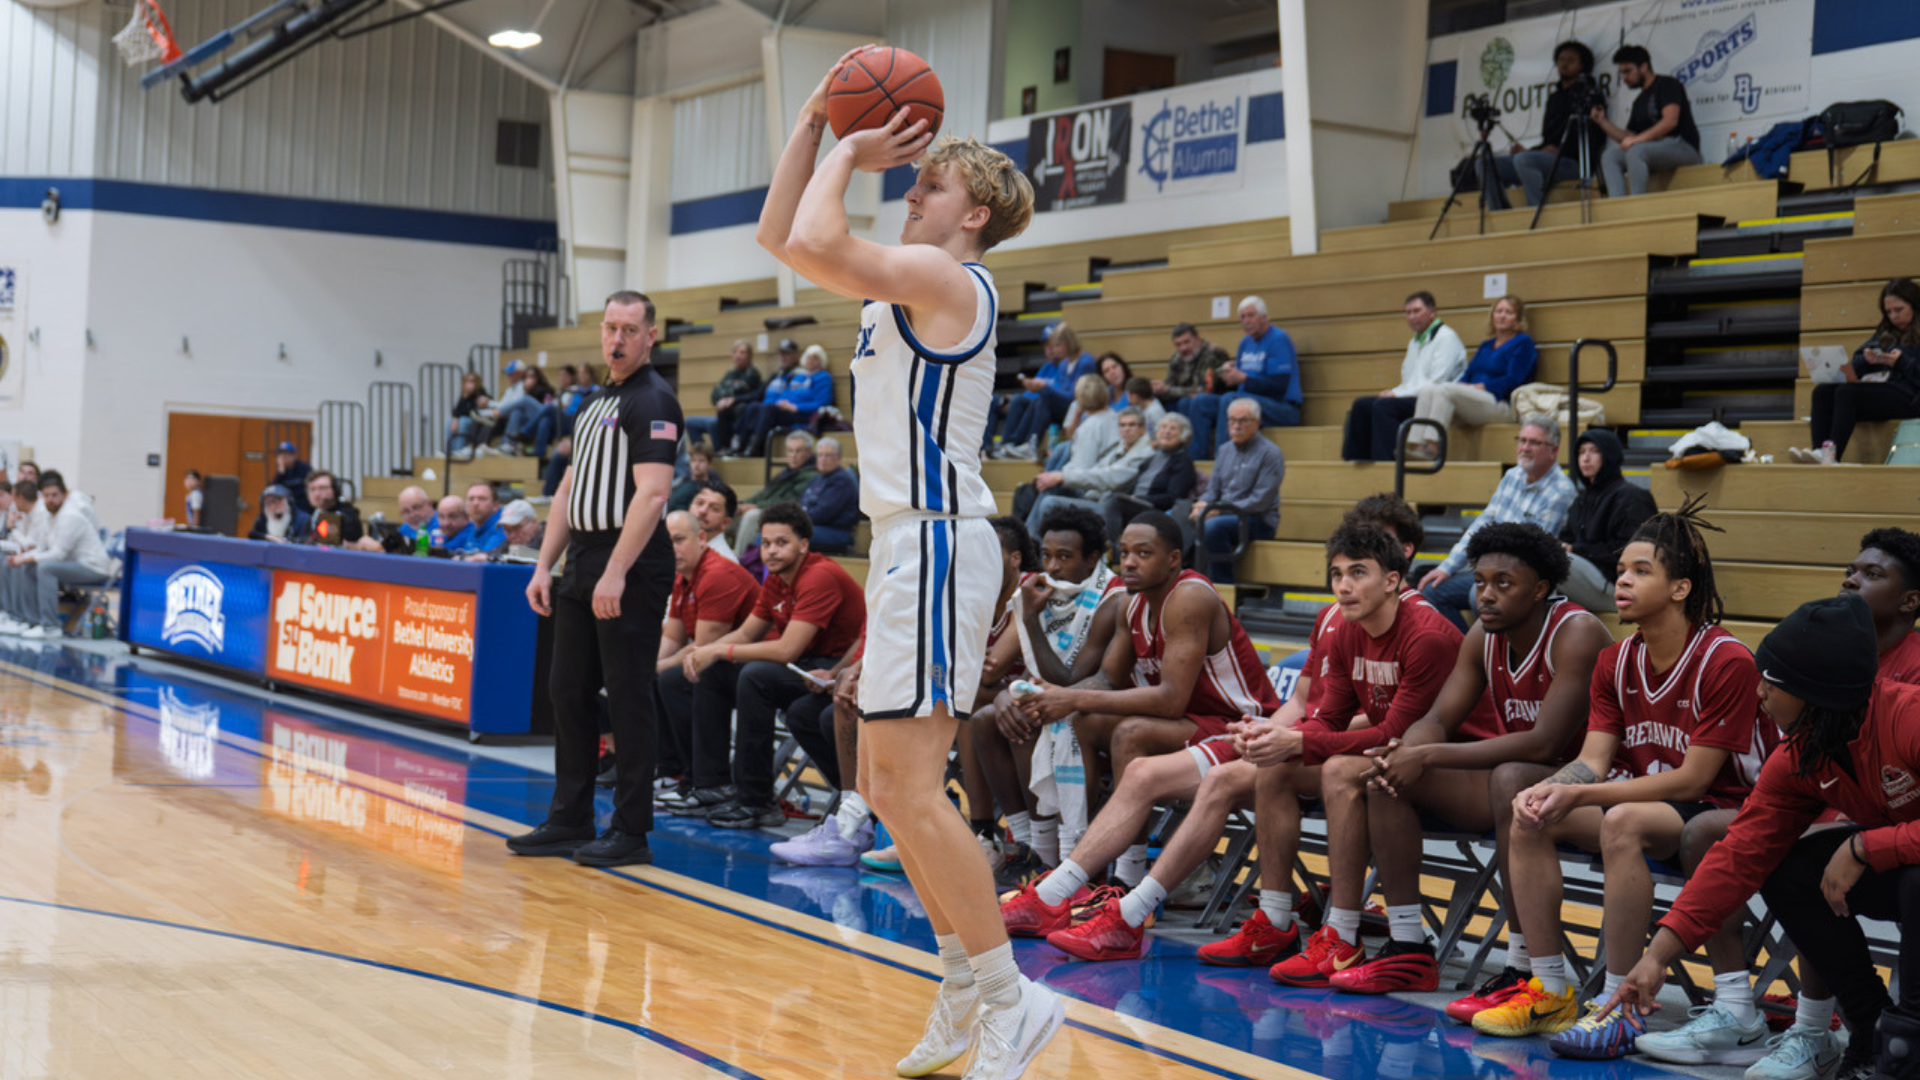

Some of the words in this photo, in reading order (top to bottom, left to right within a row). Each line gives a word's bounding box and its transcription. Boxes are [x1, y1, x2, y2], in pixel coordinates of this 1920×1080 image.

[1675, 21, 1754, 85] SPORTS
[1503, 72, 1612, 115] OUTR
[1733, 73, 1762, 115] BU
[1046, 107, 1112, 166] IRON
[1173, 96, 1240, 138] Bethel
[1174, 141, 1235, 175] Alumni
[164, 572, 224, 642] BETHEL
[300, 583, 377, 639] Source
[404, 596, 428, 618] Proud
[427, 603, 457, 624] sponsor
[457, 602, 469, 624] of
[297, 630, 354, 684] Bank
[393, 620, 425, 647] Bethel
[426, 625, 475, 662] University
[409, 652, 455, 684] Athletics
[1625, 721, 1690, 755] REDAWKS
